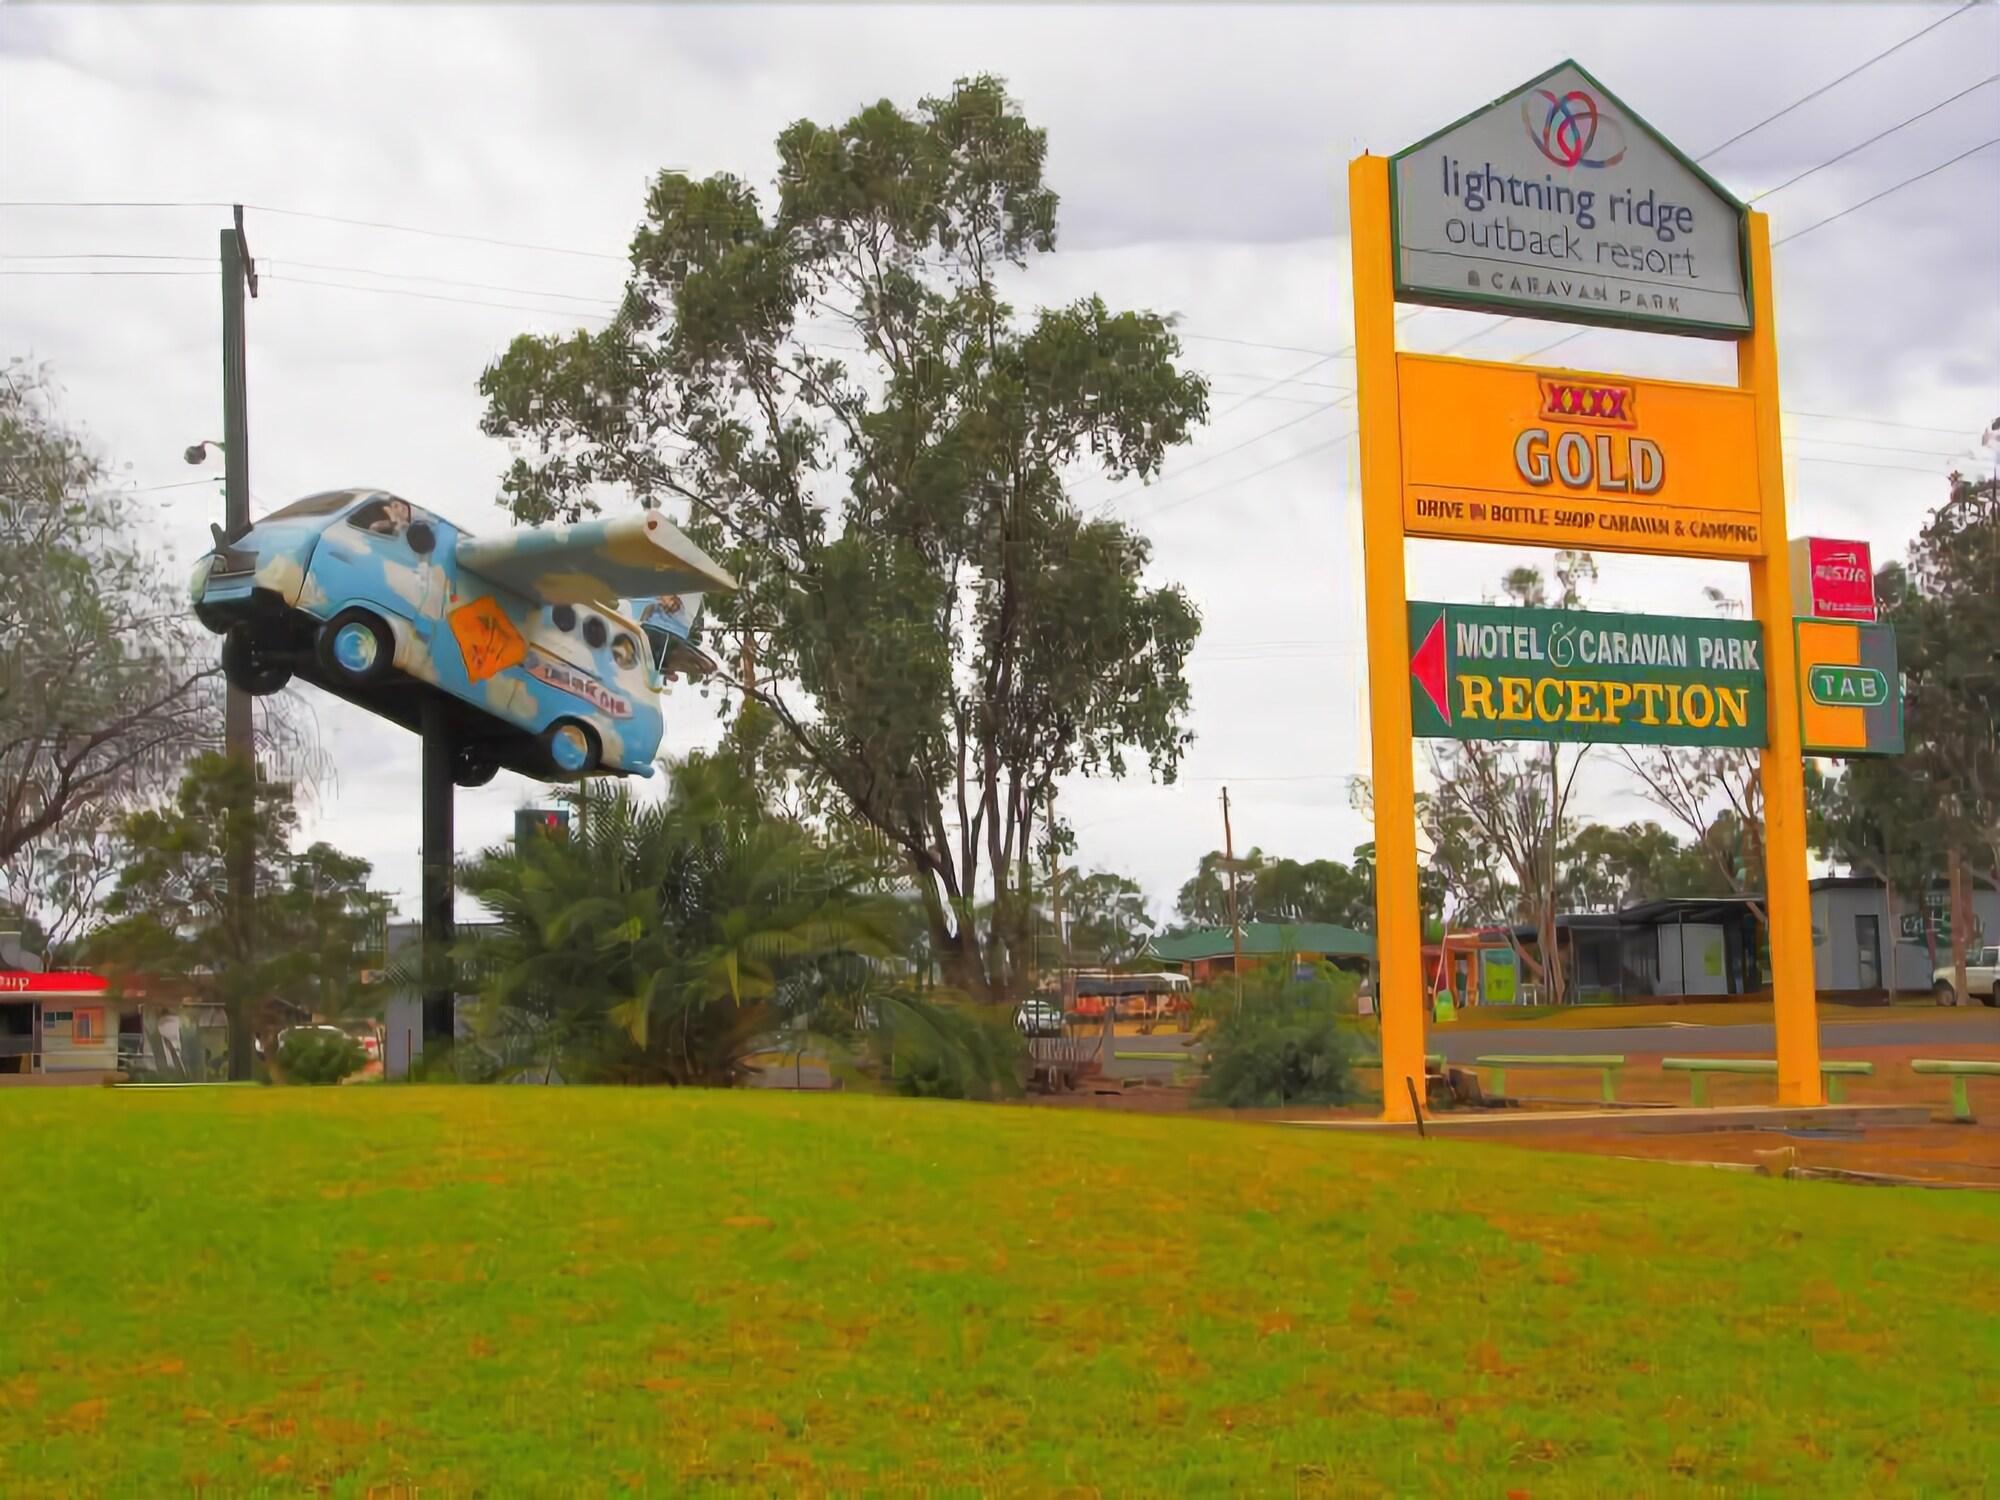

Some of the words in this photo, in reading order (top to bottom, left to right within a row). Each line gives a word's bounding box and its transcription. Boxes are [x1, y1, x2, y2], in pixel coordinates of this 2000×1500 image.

[1443, 155, 1596, 230] lightning
[1609, 190, 1694, 242] ridge
[1446, 218, 1582, 261] outback
[1597, 241, 1699, 278] resort
[1491, 272, 1608, 301] CARAVAN
[1620, 289, 1680, 312] PARK
[1547, 382, 1628, 421] XXXX
[1513, 428, 1665, 495] GOLD
[1416, 499, 1464, 519] DRIVE
[1491, 505, 1549, 526] BOTTLE
[1674, 520, 1685, 537] &
[1456, 622, 1545, 661] MOTEL
[1579, 630, 1687, 667] CARAVAN
[1698, 636, 1760, 671] PARK
[1456, 674, 1750, 728] RECEPTION
[1819, 674, 1878, 698] TAB
